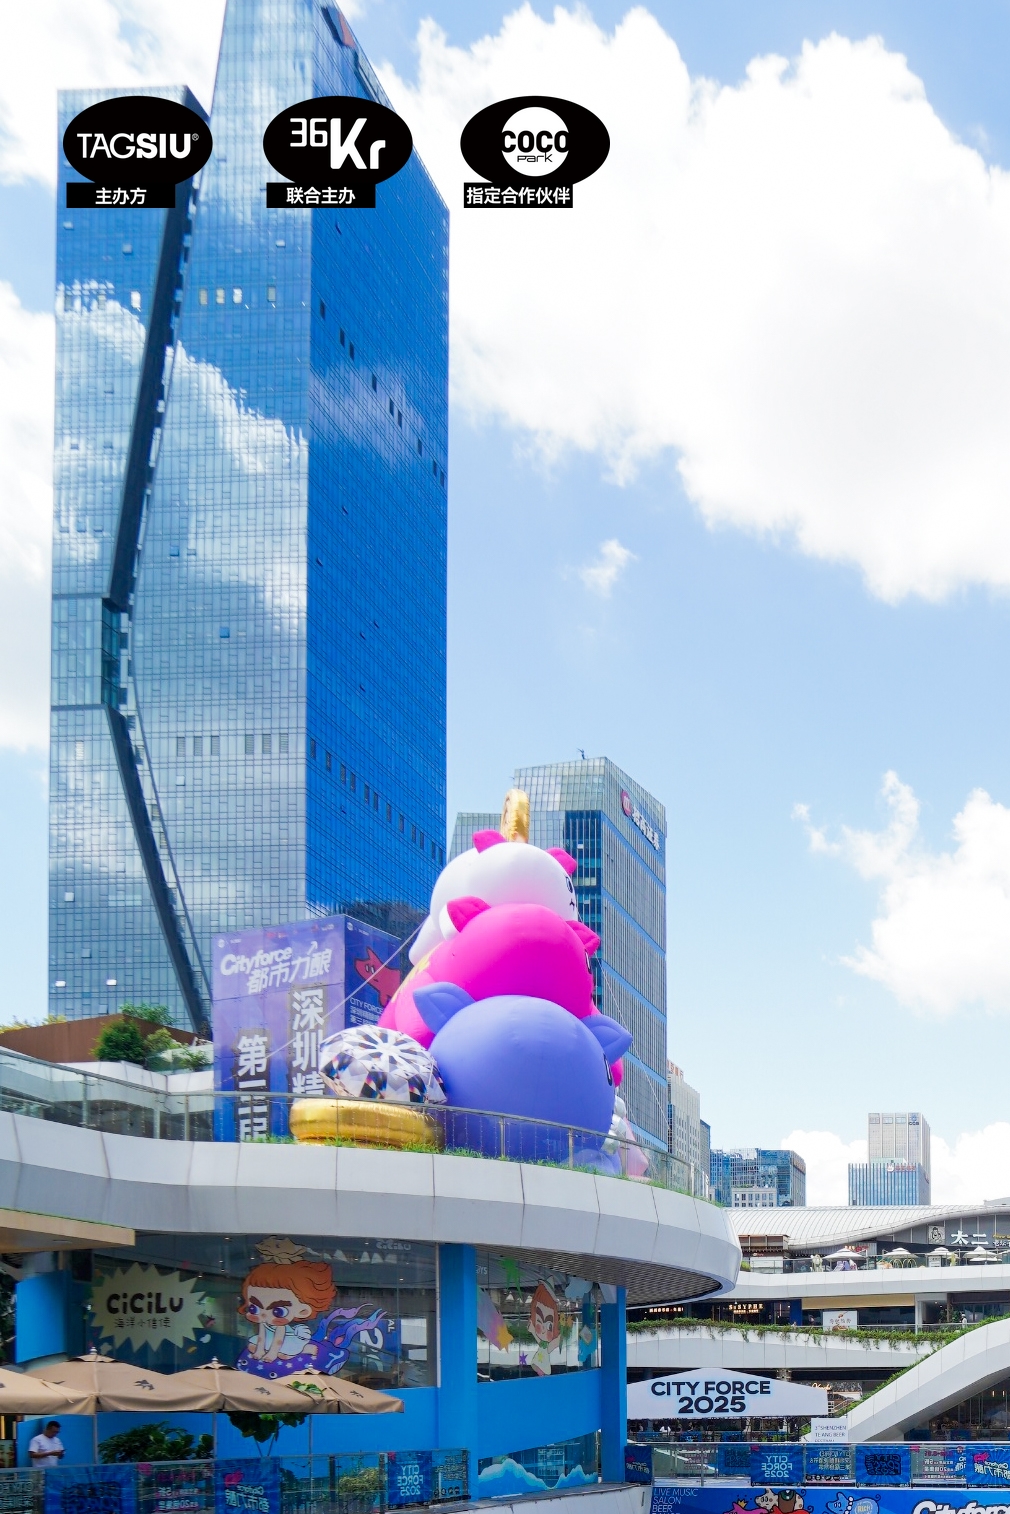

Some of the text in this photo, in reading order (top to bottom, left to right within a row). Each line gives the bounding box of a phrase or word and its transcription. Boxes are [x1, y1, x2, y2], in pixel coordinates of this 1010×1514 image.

[220, 946, 293, 976] Cityforce
[247, 948, 333, 995] 都市力酿
[950, 1229, 989, 1246] 太二
[651, 1380, 771, 1397] CITY FORCE
[678, 1396, 747, 1414] 2025
[653, 1496, 682, 1505] SALON
[654, 1488, 698, 1497] LIVE MUSIC
[652, 1504, 673, 1513] BEER
